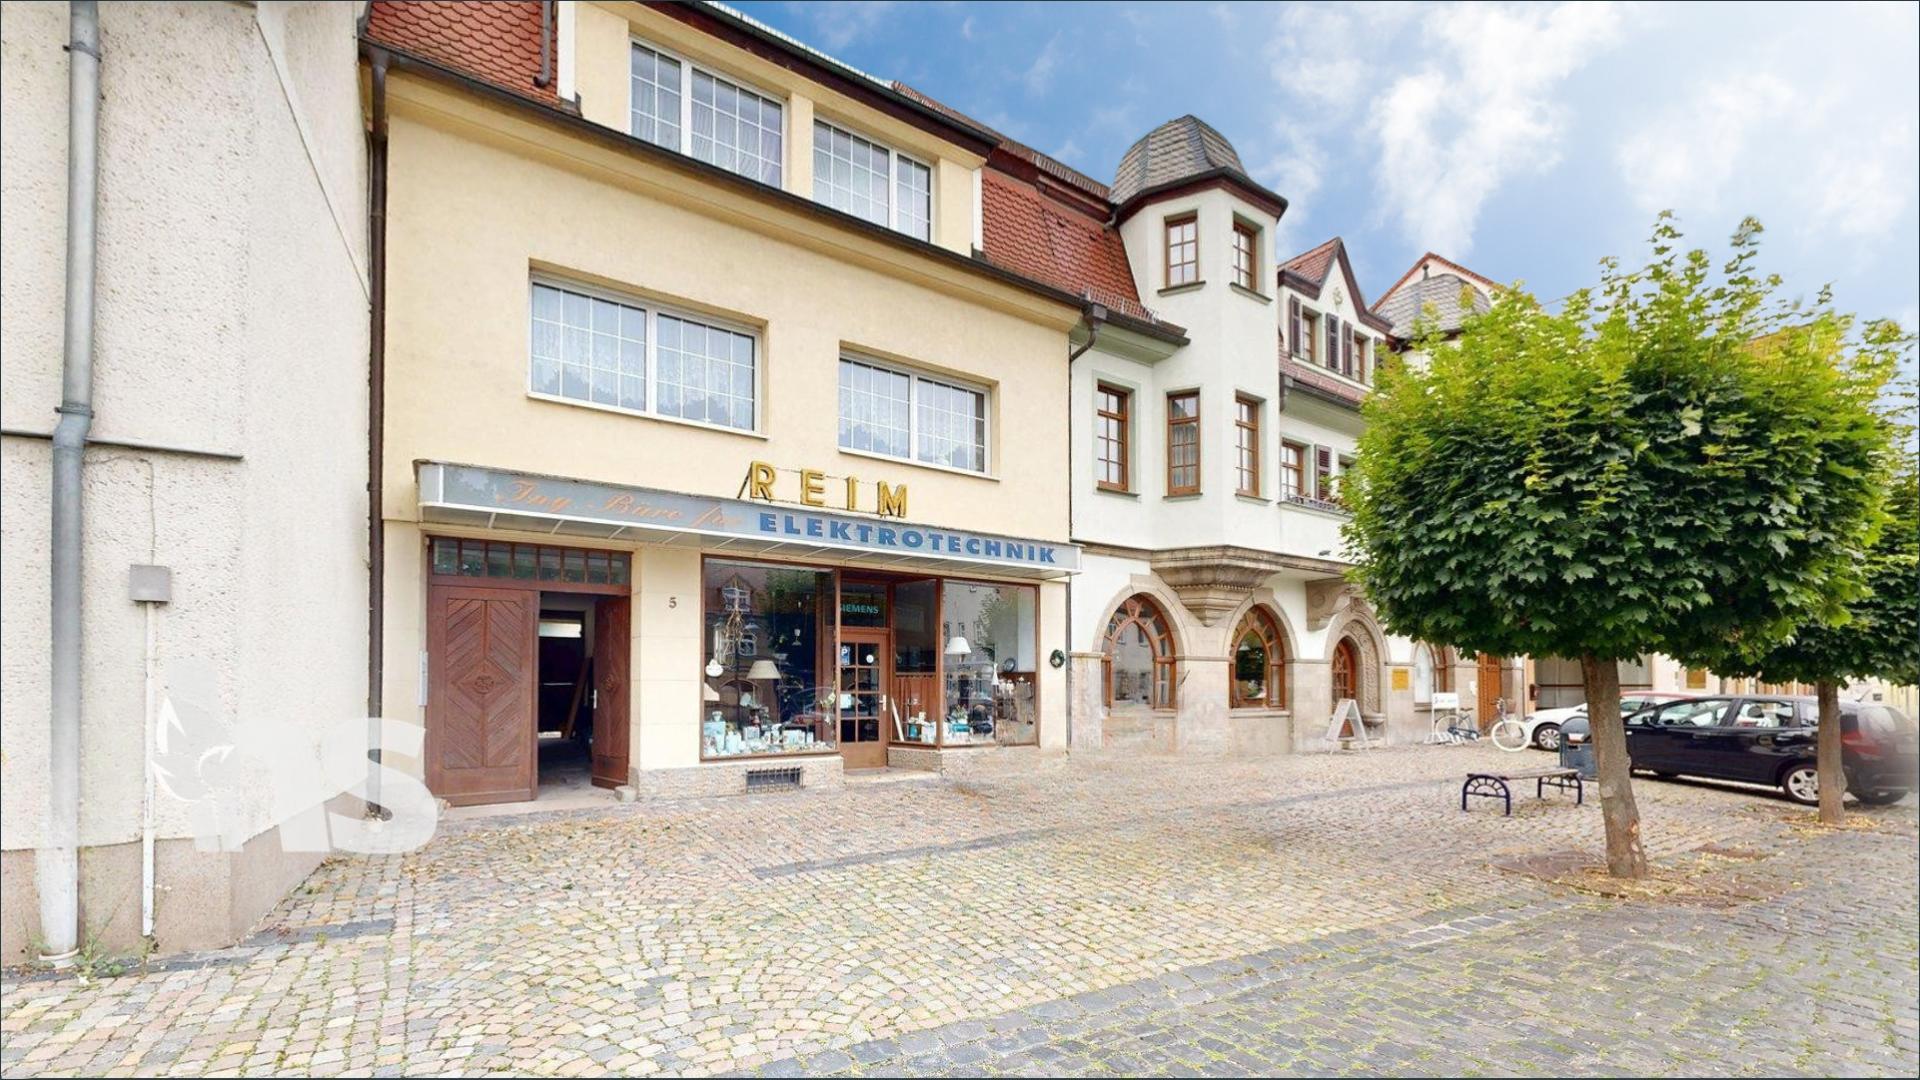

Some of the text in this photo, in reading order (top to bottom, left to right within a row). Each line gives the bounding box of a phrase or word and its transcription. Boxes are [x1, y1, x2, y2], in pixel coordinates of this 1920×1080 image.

[750, 460, 908, 518] REIM
[759, 511, 1056, 564] ELEKTROTECHNIK
[668, 596, 677, 609] 5
[840, 603, 879, 614] IEMENS
